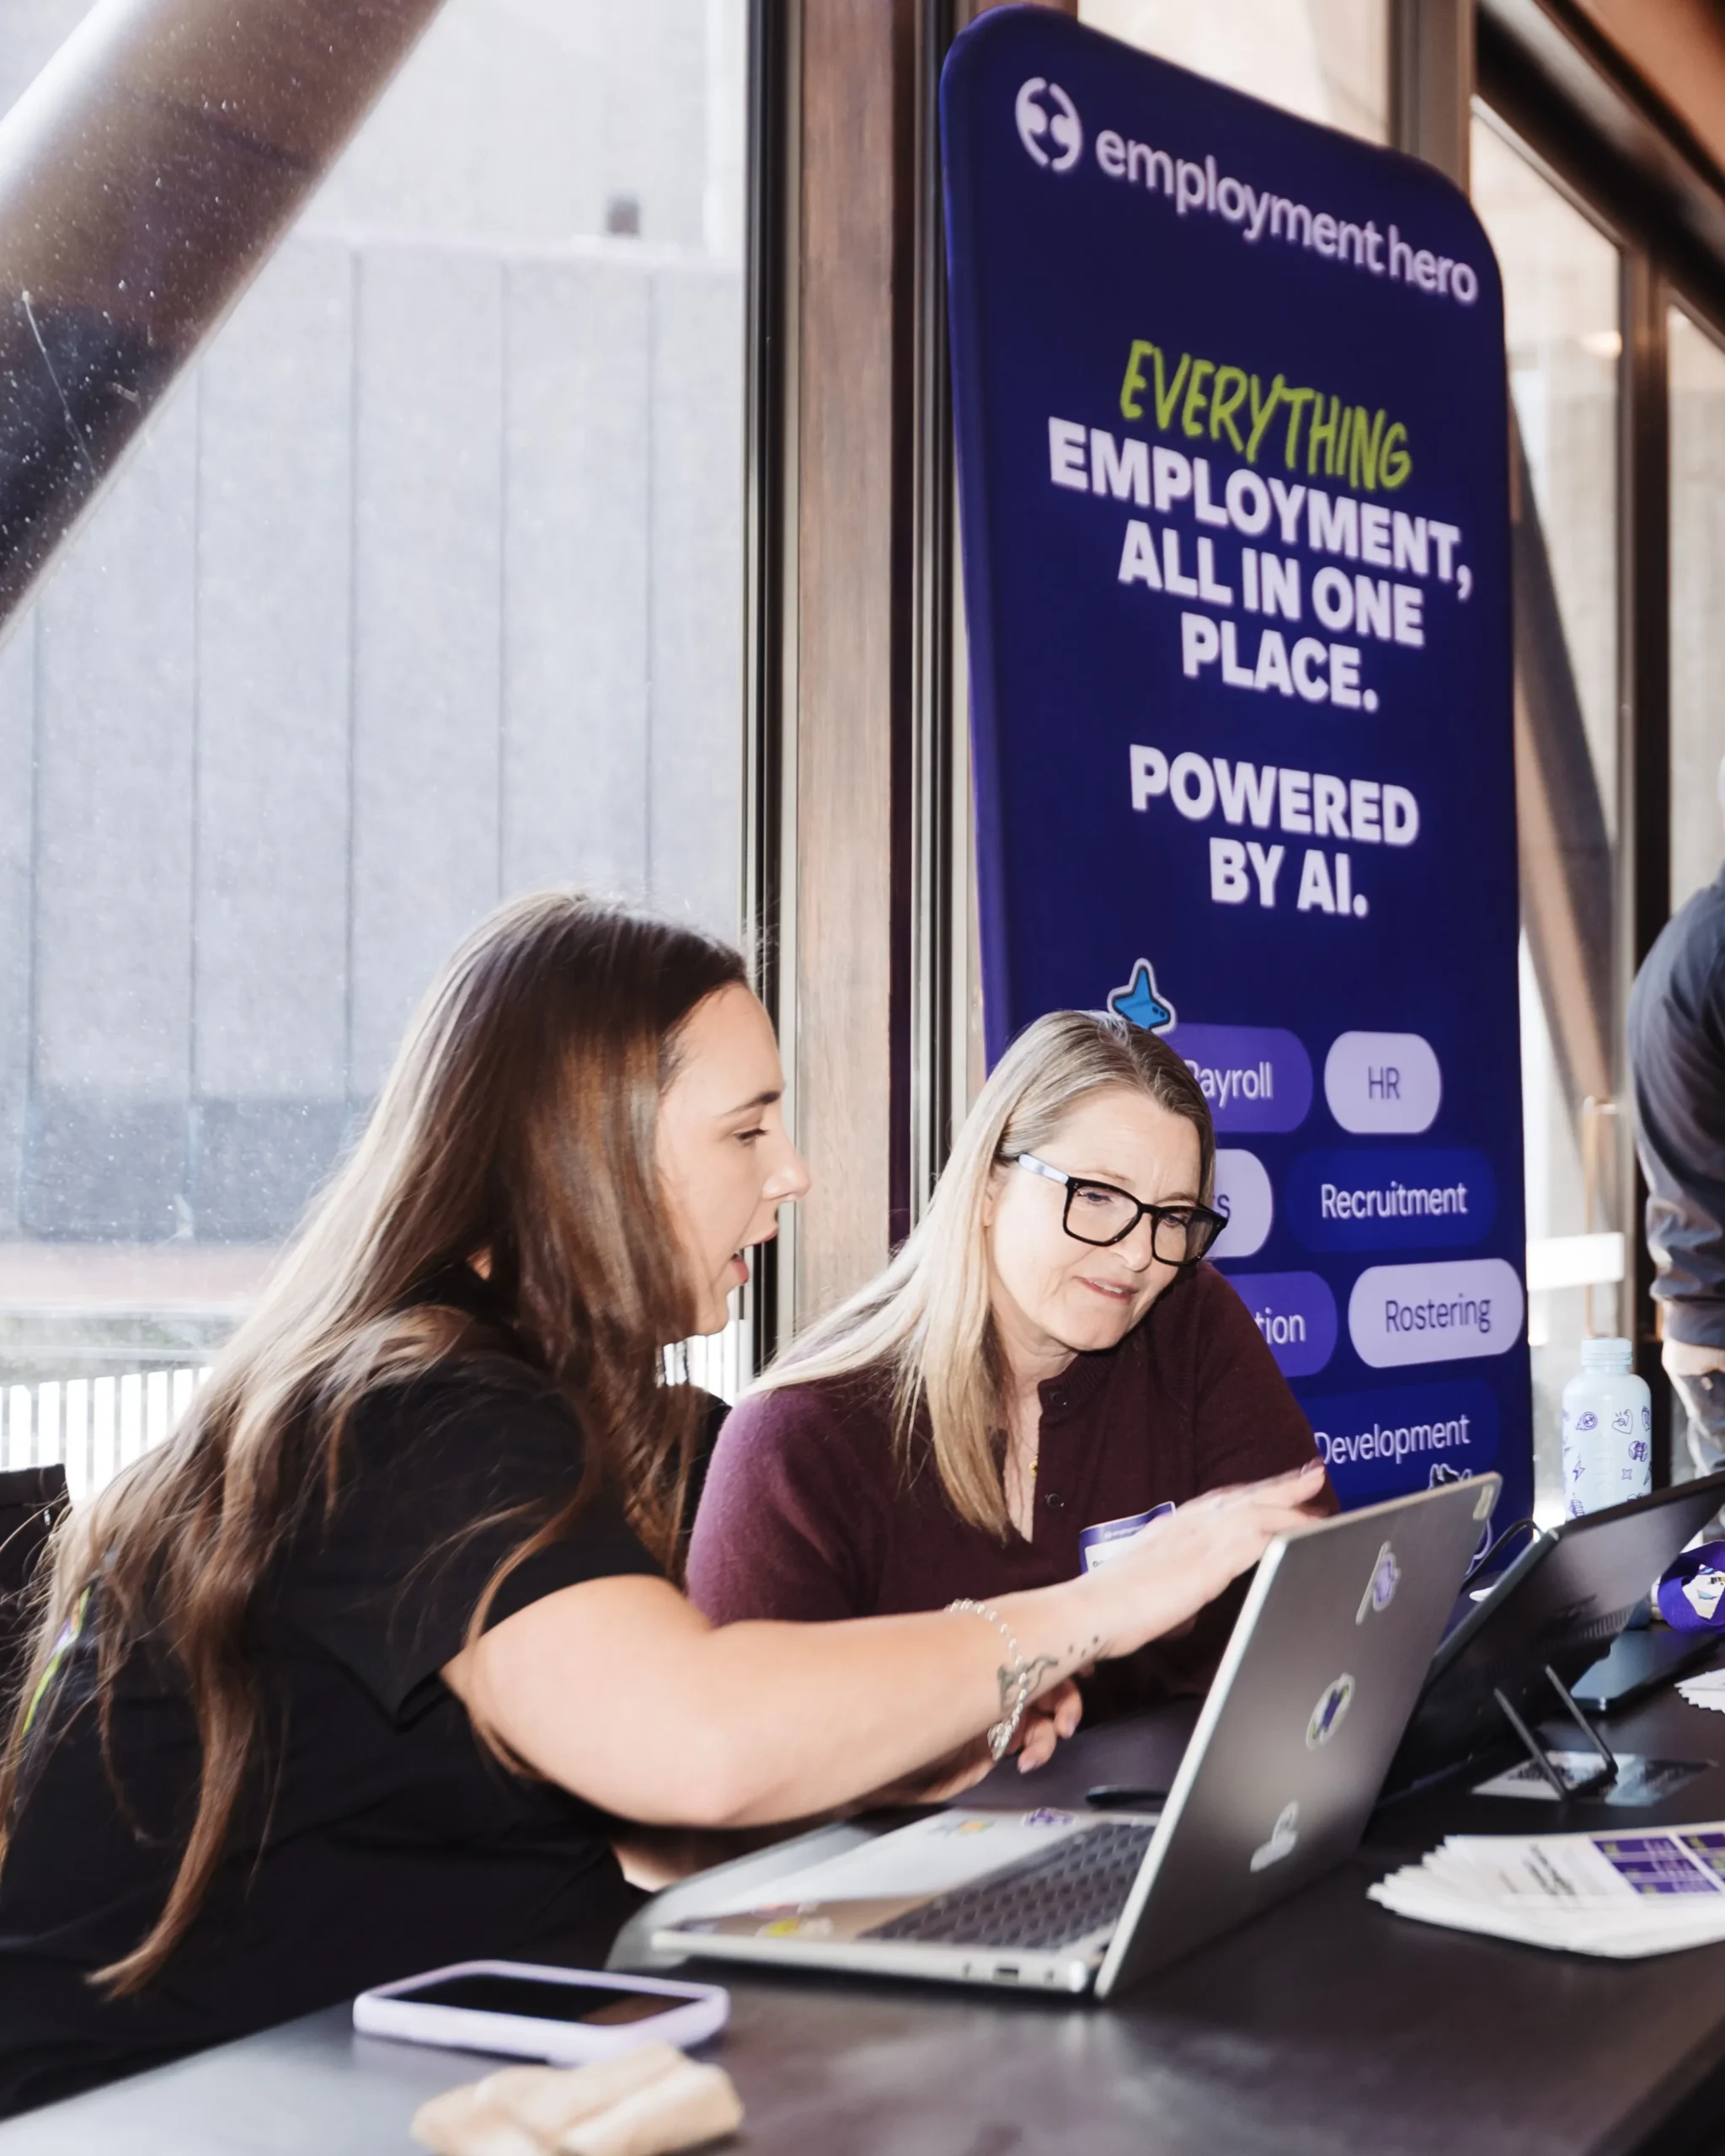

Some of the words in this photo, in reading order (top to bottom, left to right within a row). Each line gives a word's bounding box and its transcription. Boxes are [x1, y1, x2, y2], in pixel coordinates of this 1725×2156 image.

[1096, 130, 1385, 273] employment
[1388, 224, 1478, 303] hero
[1120, 339, 1413, 491] EVERYTHING
[1048, 416, 1472, 600] EMPLOYMENT,
[1118, 519, 1233, 606] ALL
[1242, 547, 1301, 622] IN
[1311, 566, 1424, 648] ONE
[1181, 611, 1380, 712] PLACE.
[1130, 744, 1420, 847] POWERED
[1209, 836, 1284, 908] BY
[1296, 849, 1369, 918] AI.
[1367, 1065, 1401, 1100] HR
[1321, 1181, 1469, 1220] Recruitment
[1385, 1293, 1493, 1333] Rostering
[1314, 1414, 1471, 1465] Development
